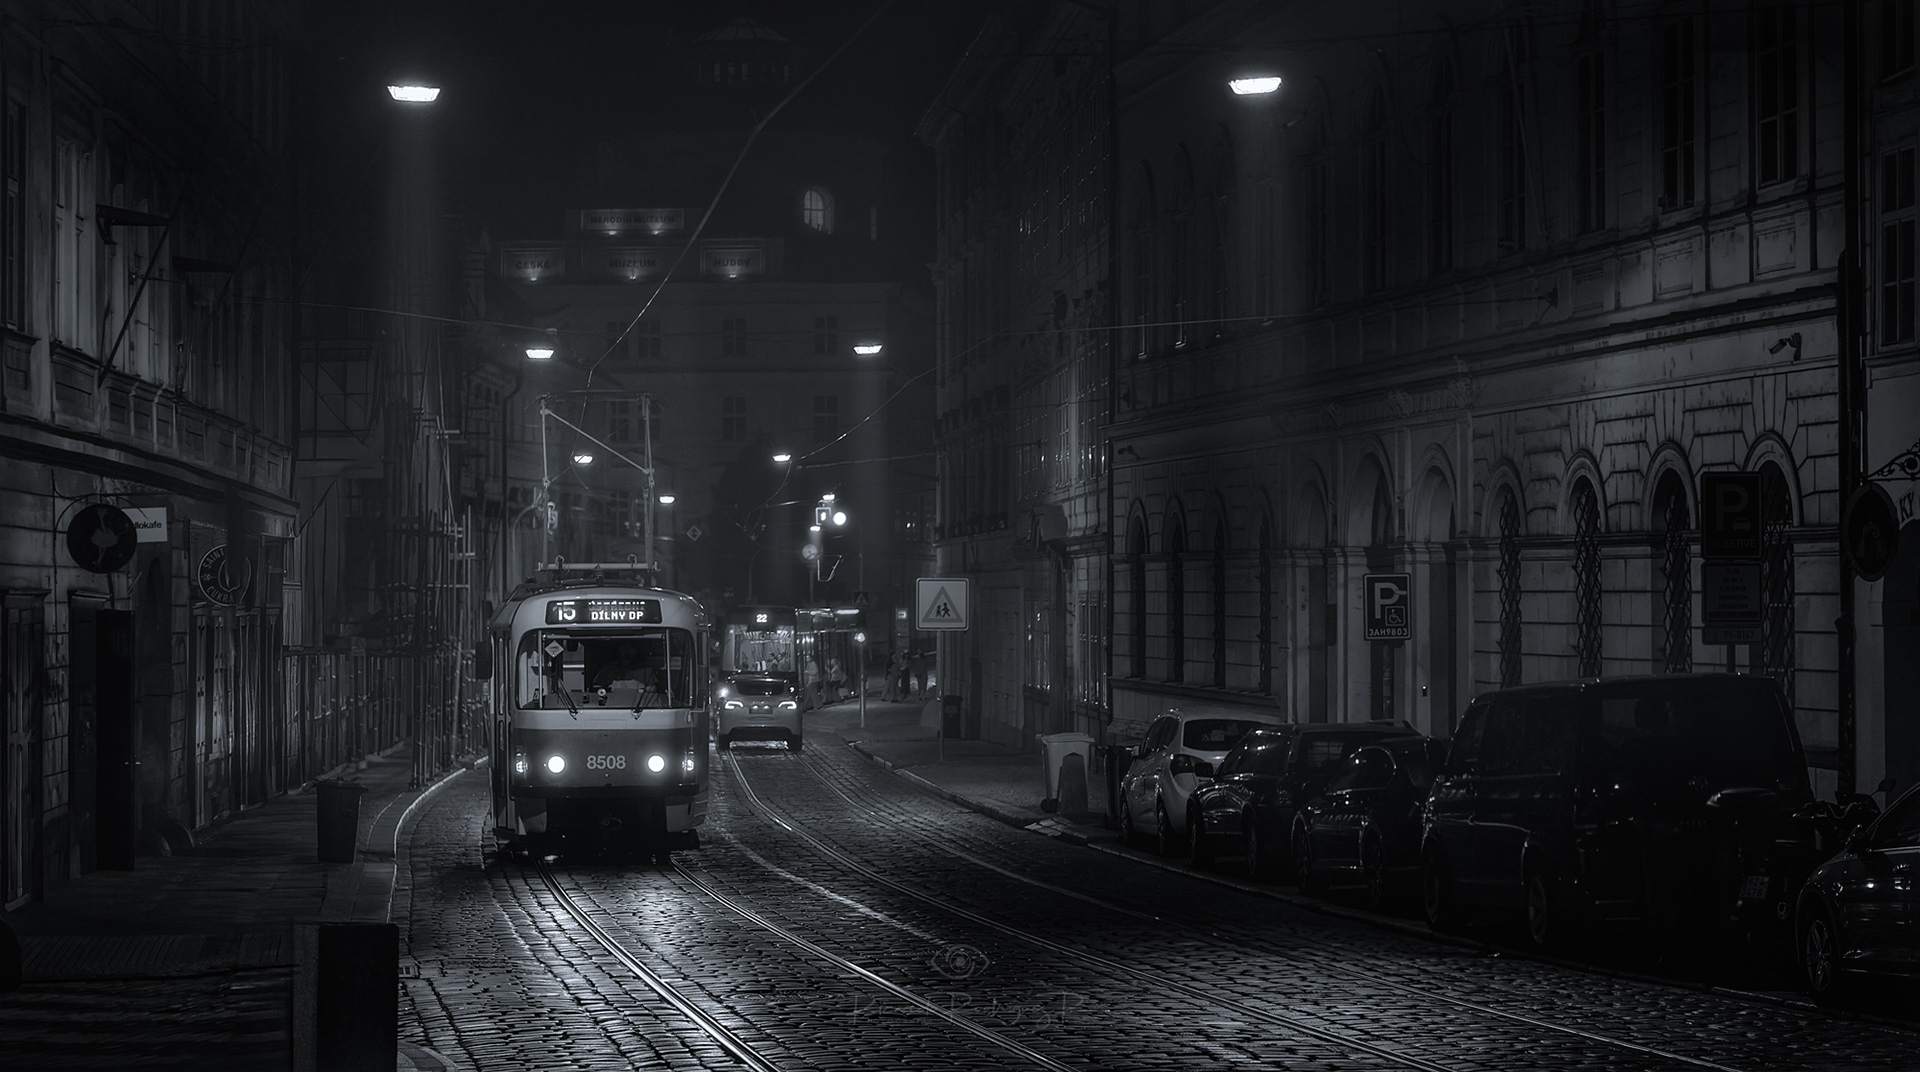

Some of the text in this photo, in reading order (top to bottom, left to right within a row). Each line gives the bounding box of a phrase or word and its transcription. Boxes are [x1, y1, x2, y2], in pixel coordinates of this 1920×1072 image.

[609, 259, 656, 269] MUZEUM
[714, 258, 751, 268] HUDBY
[1715, 483, 1750, 532] P
[202, 547, 226, 570] SAINT
[555, 600, 577, 621] 15
[591, 610, 645, 621] DÍLNY DP
[756, 613, 768, 623] 22
[1368, 628, 1408, 637] 3AH9803
[586, 754, 627, 770] 8508
